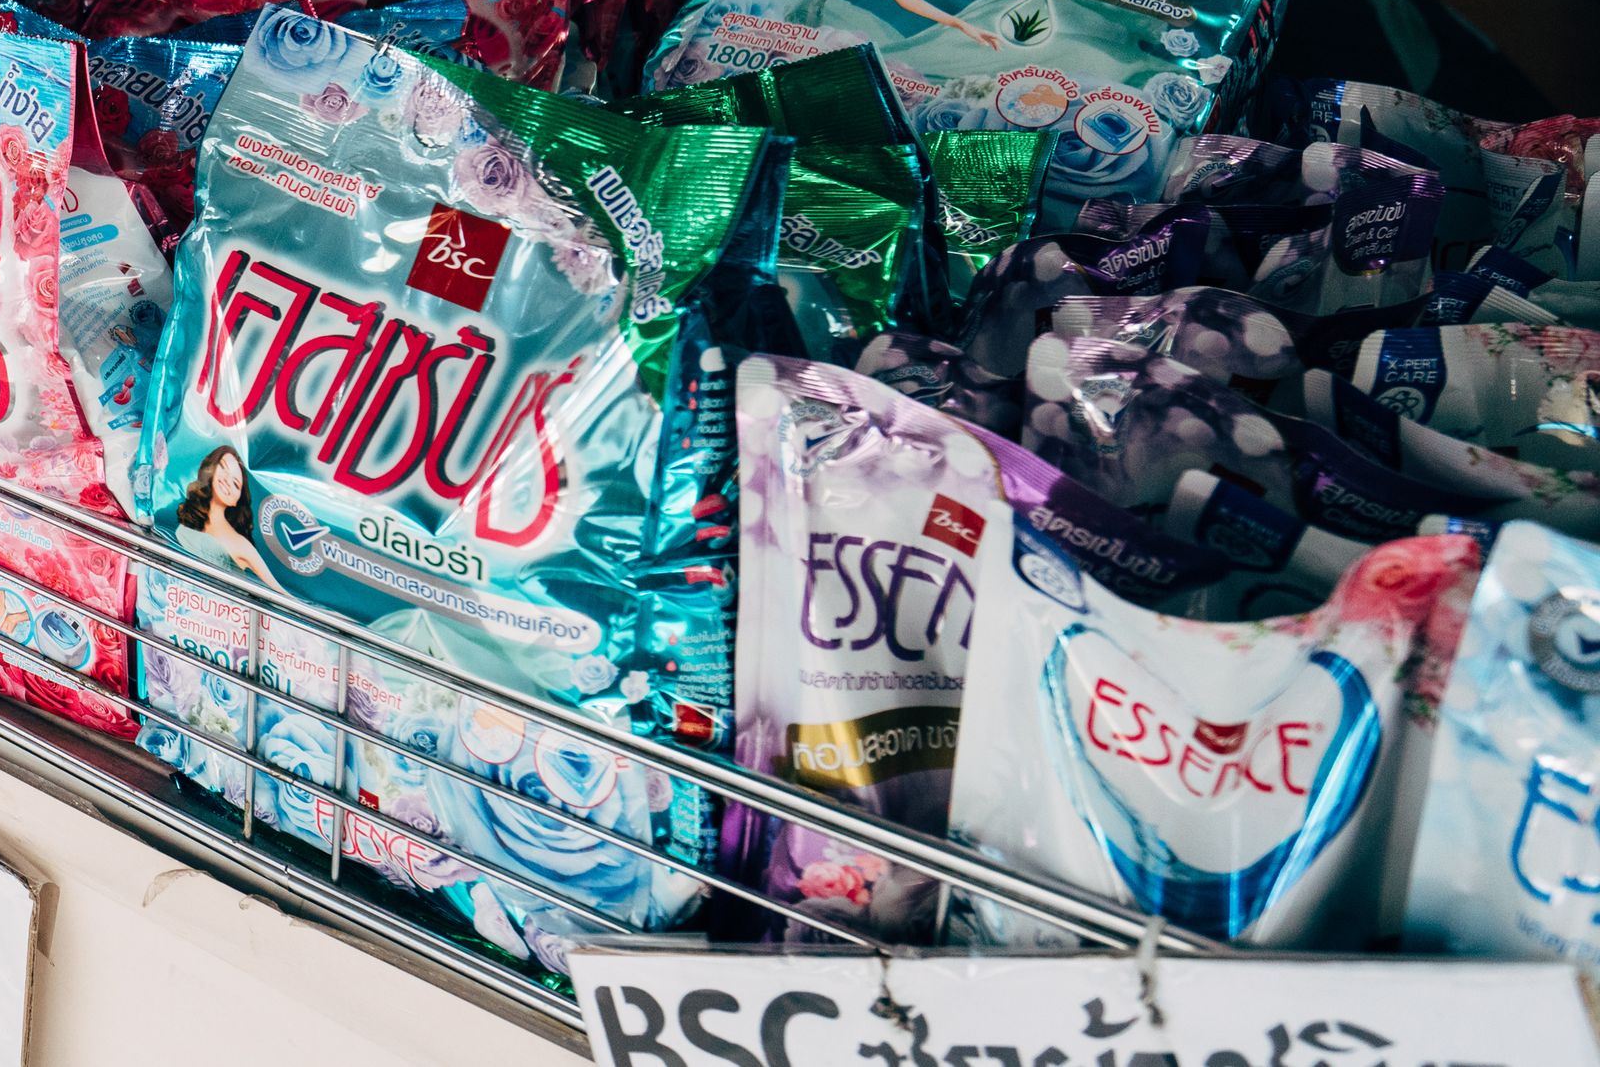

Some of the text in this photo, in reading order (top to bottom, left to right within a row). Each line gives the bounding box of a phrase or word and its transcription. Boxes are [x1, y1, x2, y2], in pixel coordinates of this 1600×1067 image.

[714, 27, 803, 55] Premium Mild
[722, 12, 820, 42] สูตรมาตรฐาน
[889, 70, 941, 97] tergent
[997, 65, 1079, 100] สำหรับซักมือ
[1084, 87, 1161, 134] เครื่องฝาบน
[414, 230, 496, 280] bsc
[1383, 370, 1437, 384] CARE
[1386, 357, 1439, 371] X-PERT
[262, 498, 313, 534] Dermatology
[931, 508, 980, 543] bsc
[13, 523, 51, 549] Perfume
[358, 515, 485, 582] อโลเวร่า
[289, 553, 321, 572] Tested
[166, 584, 271, 632] สูตรมาตรฐน
[800, 533, 976, 662] ESSEN
[165, 608, 403, 711] Premium Md Perfume Detergent
[1087, 677, 1310, 798] ESSENCE
[358, 794, 378, 810] bsc
[314, 797, 434, 892] ESENCE
[594, 985, 840, 1067] BSC
